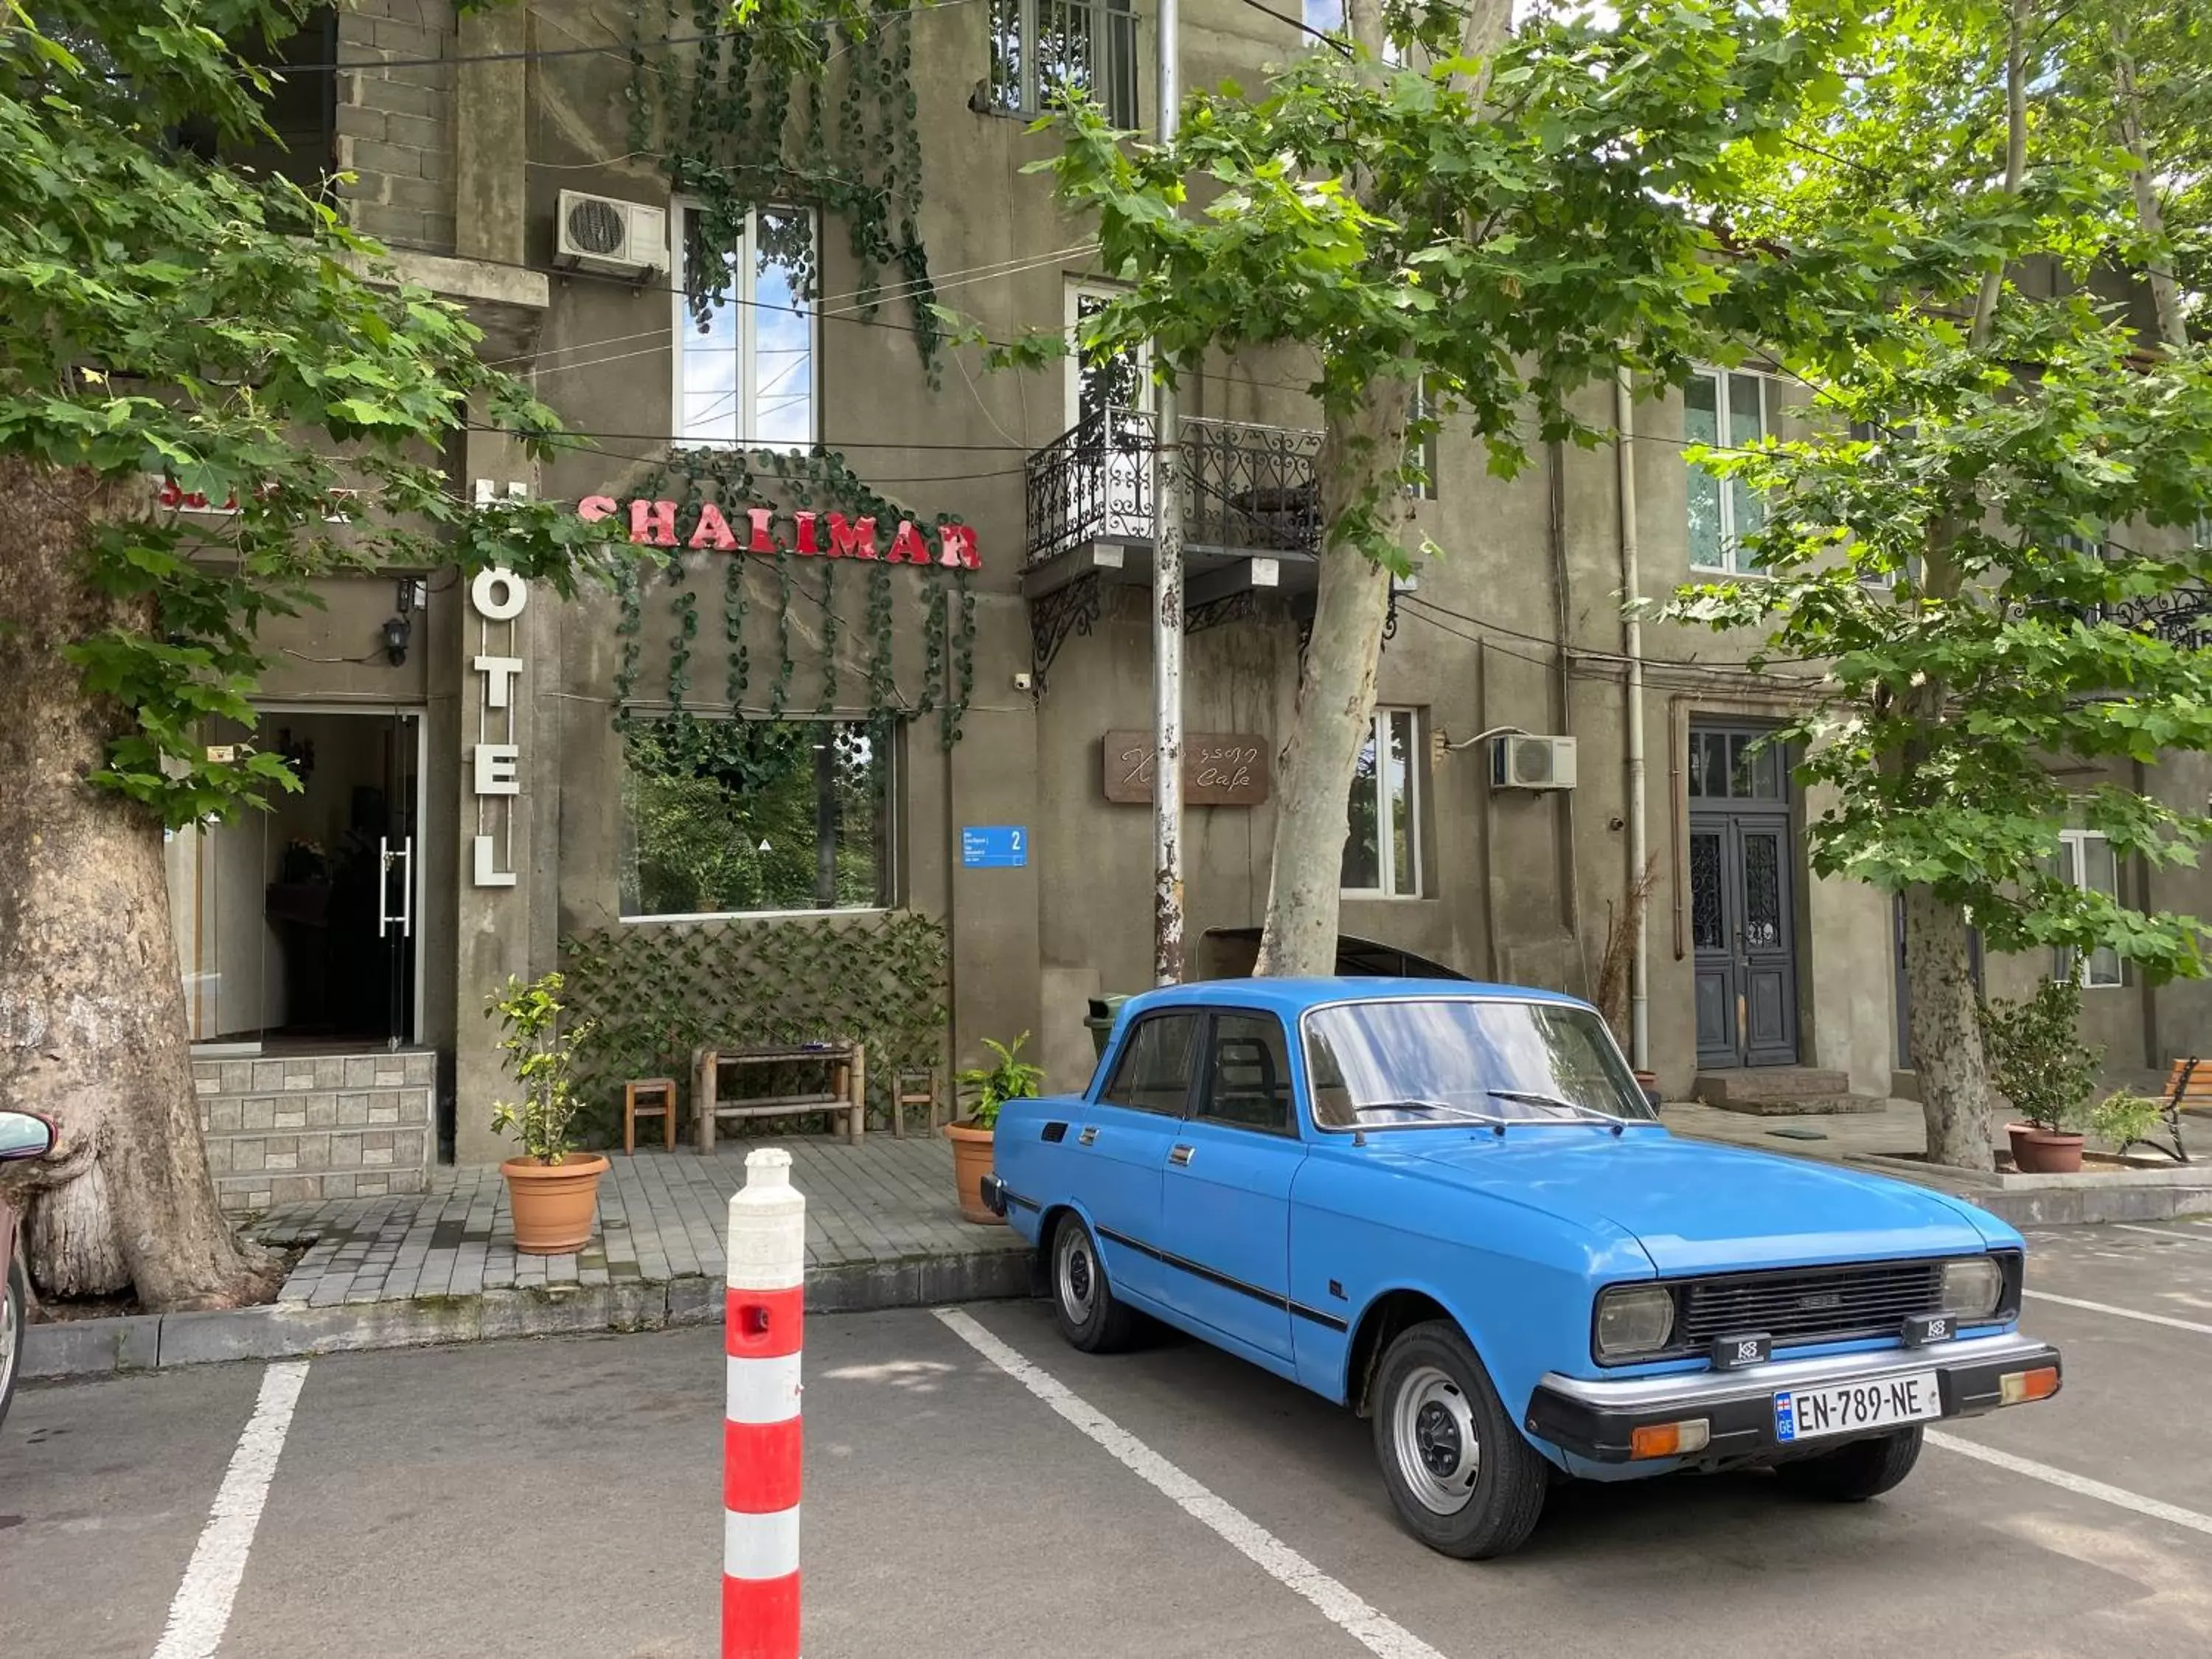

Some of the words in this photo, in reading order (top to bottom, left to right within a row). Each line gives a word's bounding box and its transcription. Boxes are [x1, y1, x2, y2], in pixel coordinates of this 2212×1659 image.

[1197, 765, 1250, 792] Cafe
[1012, 831, 1021, 850] 2
[1797, 1380, 1922, 1432] EN-789-NE
[1778, 1419, 1793, 1435] GE
